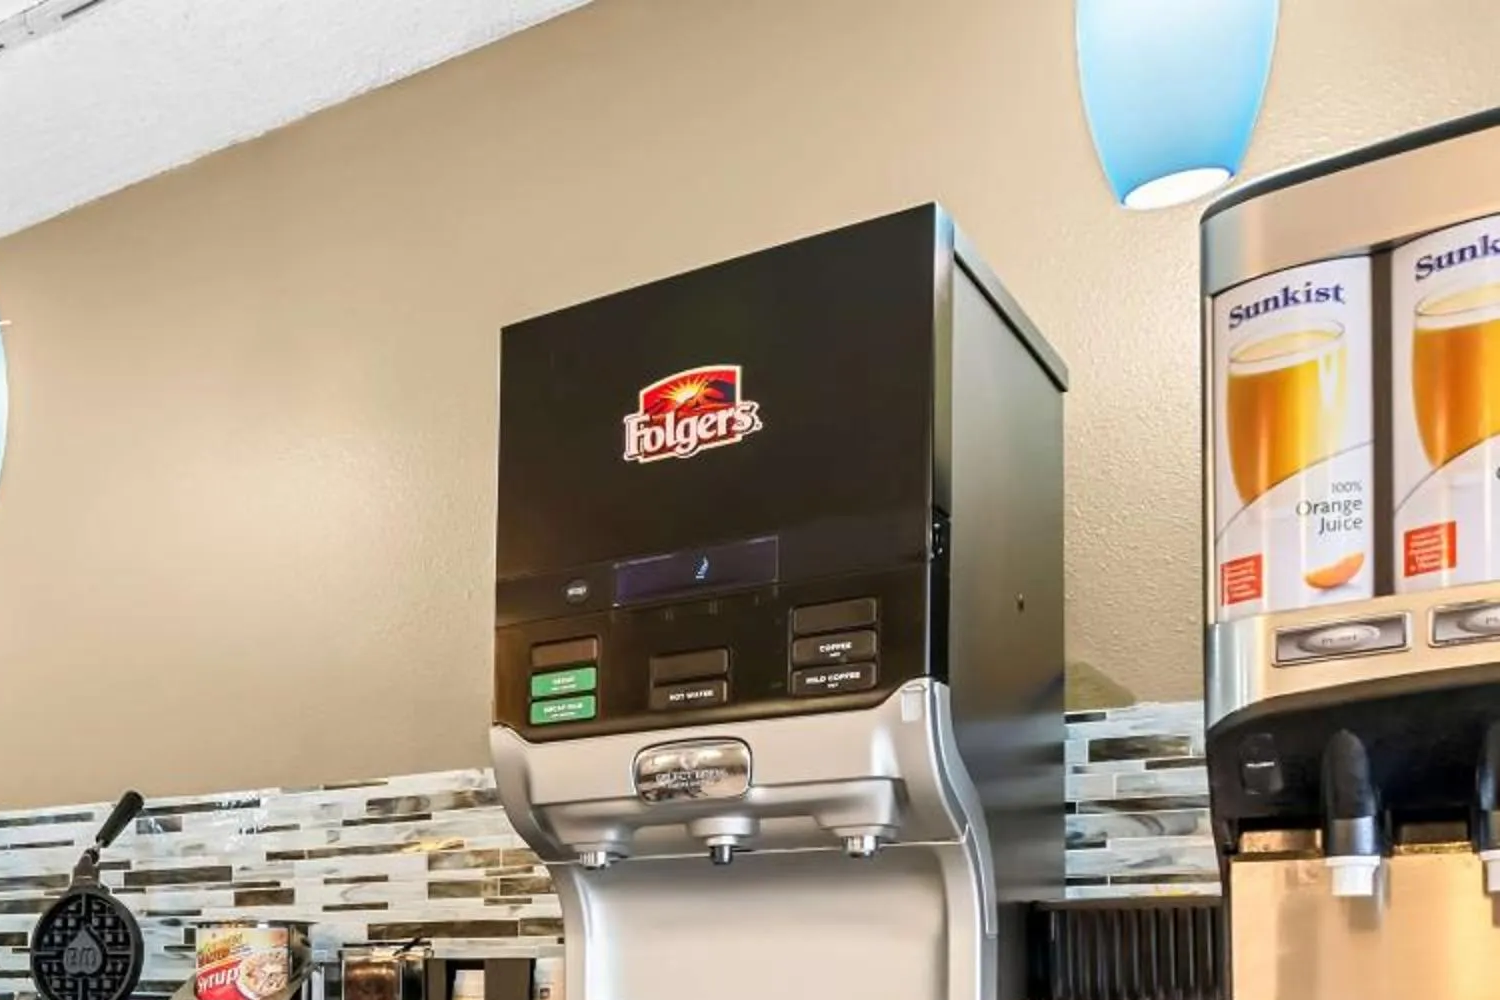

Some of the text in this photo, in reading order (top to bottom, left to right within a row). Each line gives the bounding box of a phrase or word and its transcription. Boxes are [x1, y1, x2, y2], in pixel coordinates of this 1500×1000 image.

[1227, 281, 1346, 331] Sunkist
[624, 402, 757, 459] Folgers
[1331, 480, 1363, 494] 100%
[1295, 499, 1363, 516] Orange
[1318, 515, 1363, 536] Juice
